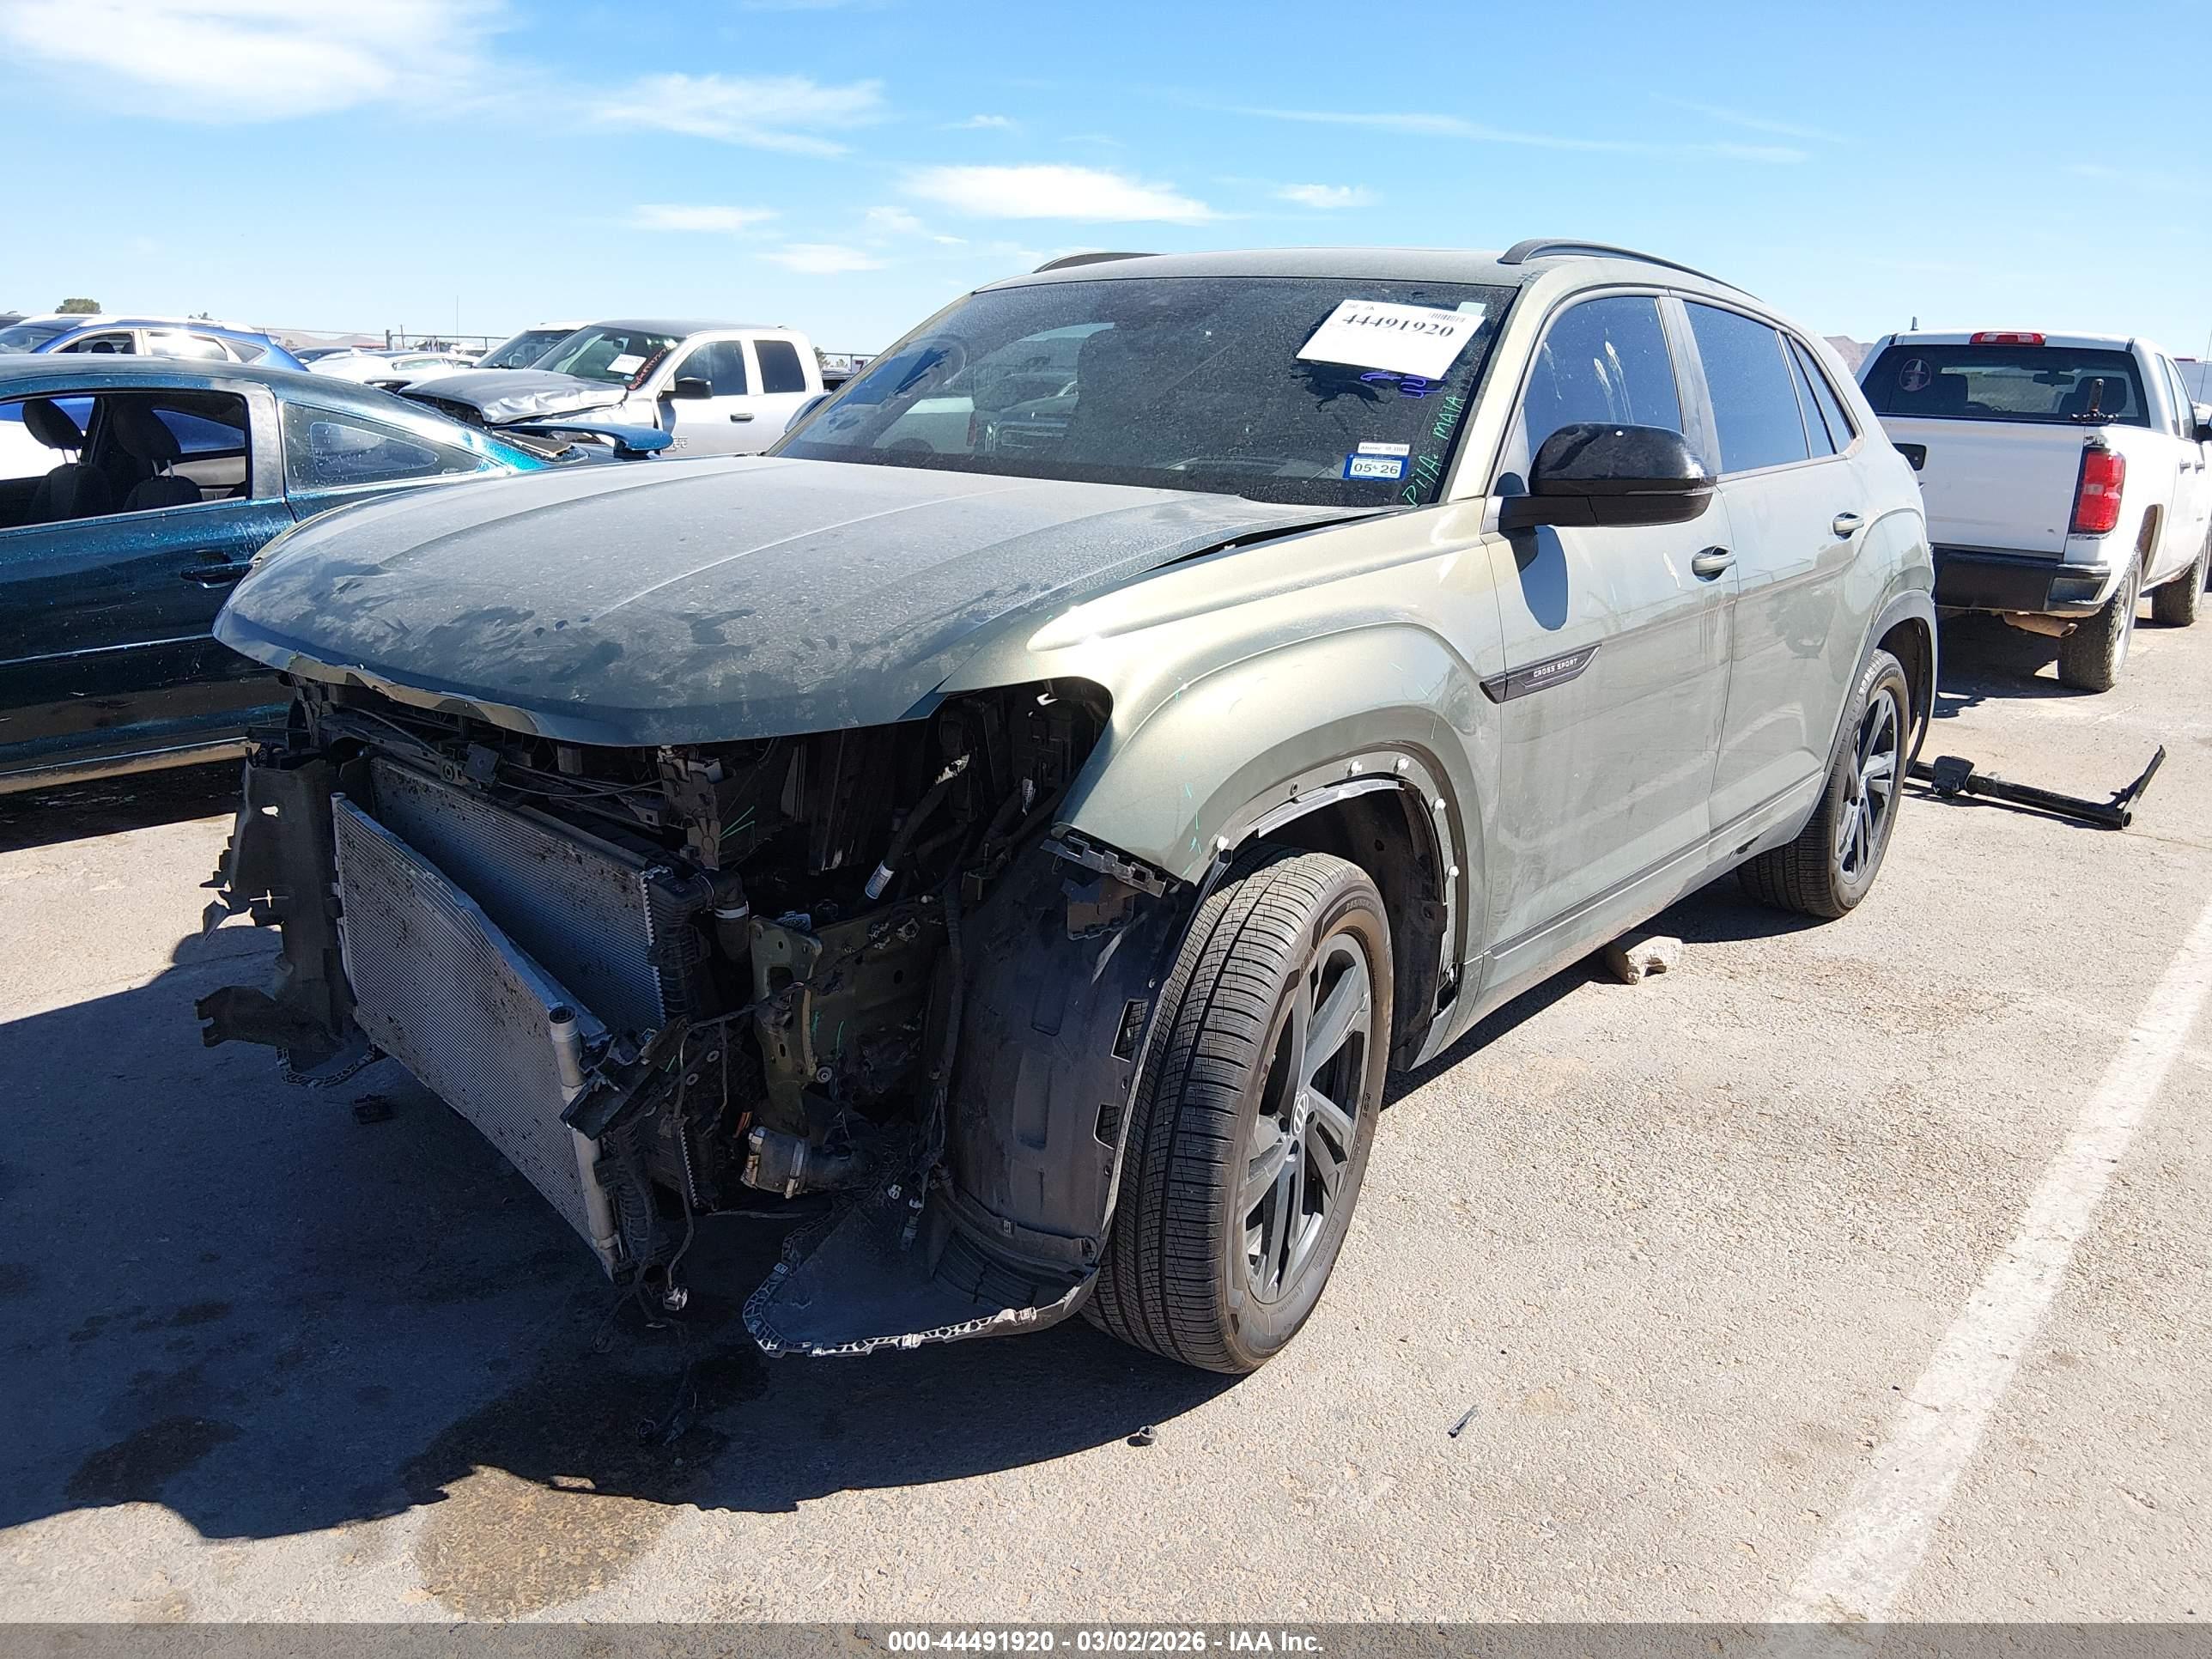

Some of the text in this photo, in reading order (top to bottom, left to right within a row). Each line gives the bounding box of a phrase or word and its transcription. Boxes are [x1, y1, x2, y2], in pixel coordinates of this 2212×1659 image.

[1342, 313, 1455, 337] 44491920
[1354, 463, 1399, 474] 05 26
[1533, 658, 1577, 678] CROSS SPORT
